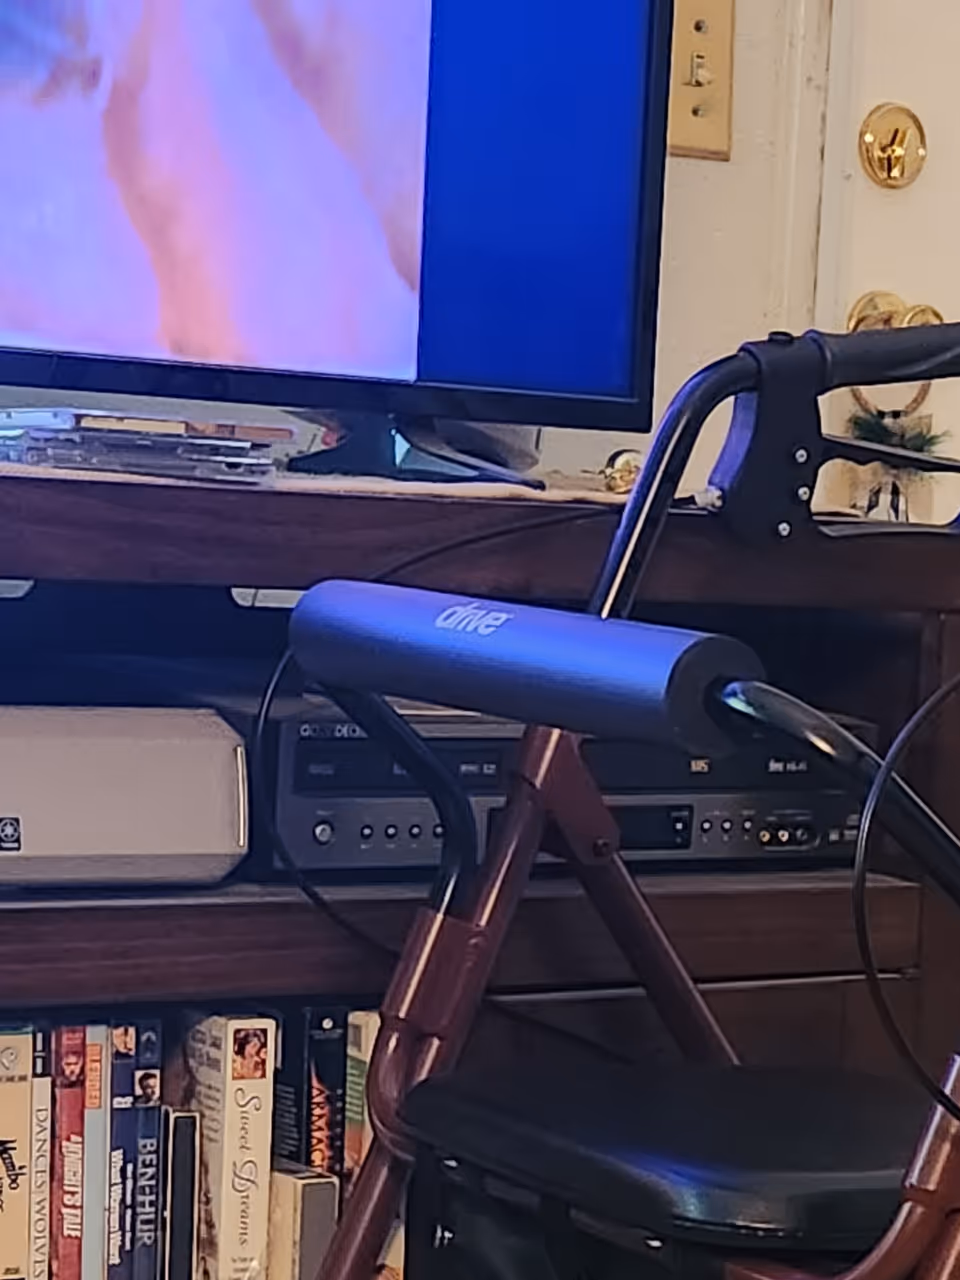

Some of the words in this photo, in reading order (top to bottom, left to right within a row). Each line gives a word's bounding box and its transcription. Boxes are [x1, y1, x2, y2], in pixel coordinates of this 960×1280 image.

[435, 601, 511, 636] drive
[34, 1107, 48, 1190] DANCES
[234, 1087, 262, 1153] Sweet
[308, 1085, 331, 1171] ARMAG
[135, 1137, 157, 1248] BEN-HUR
[231, 1159, 259, 1248] Dreams
[33, 1195, 48, 1279] WOLVES
